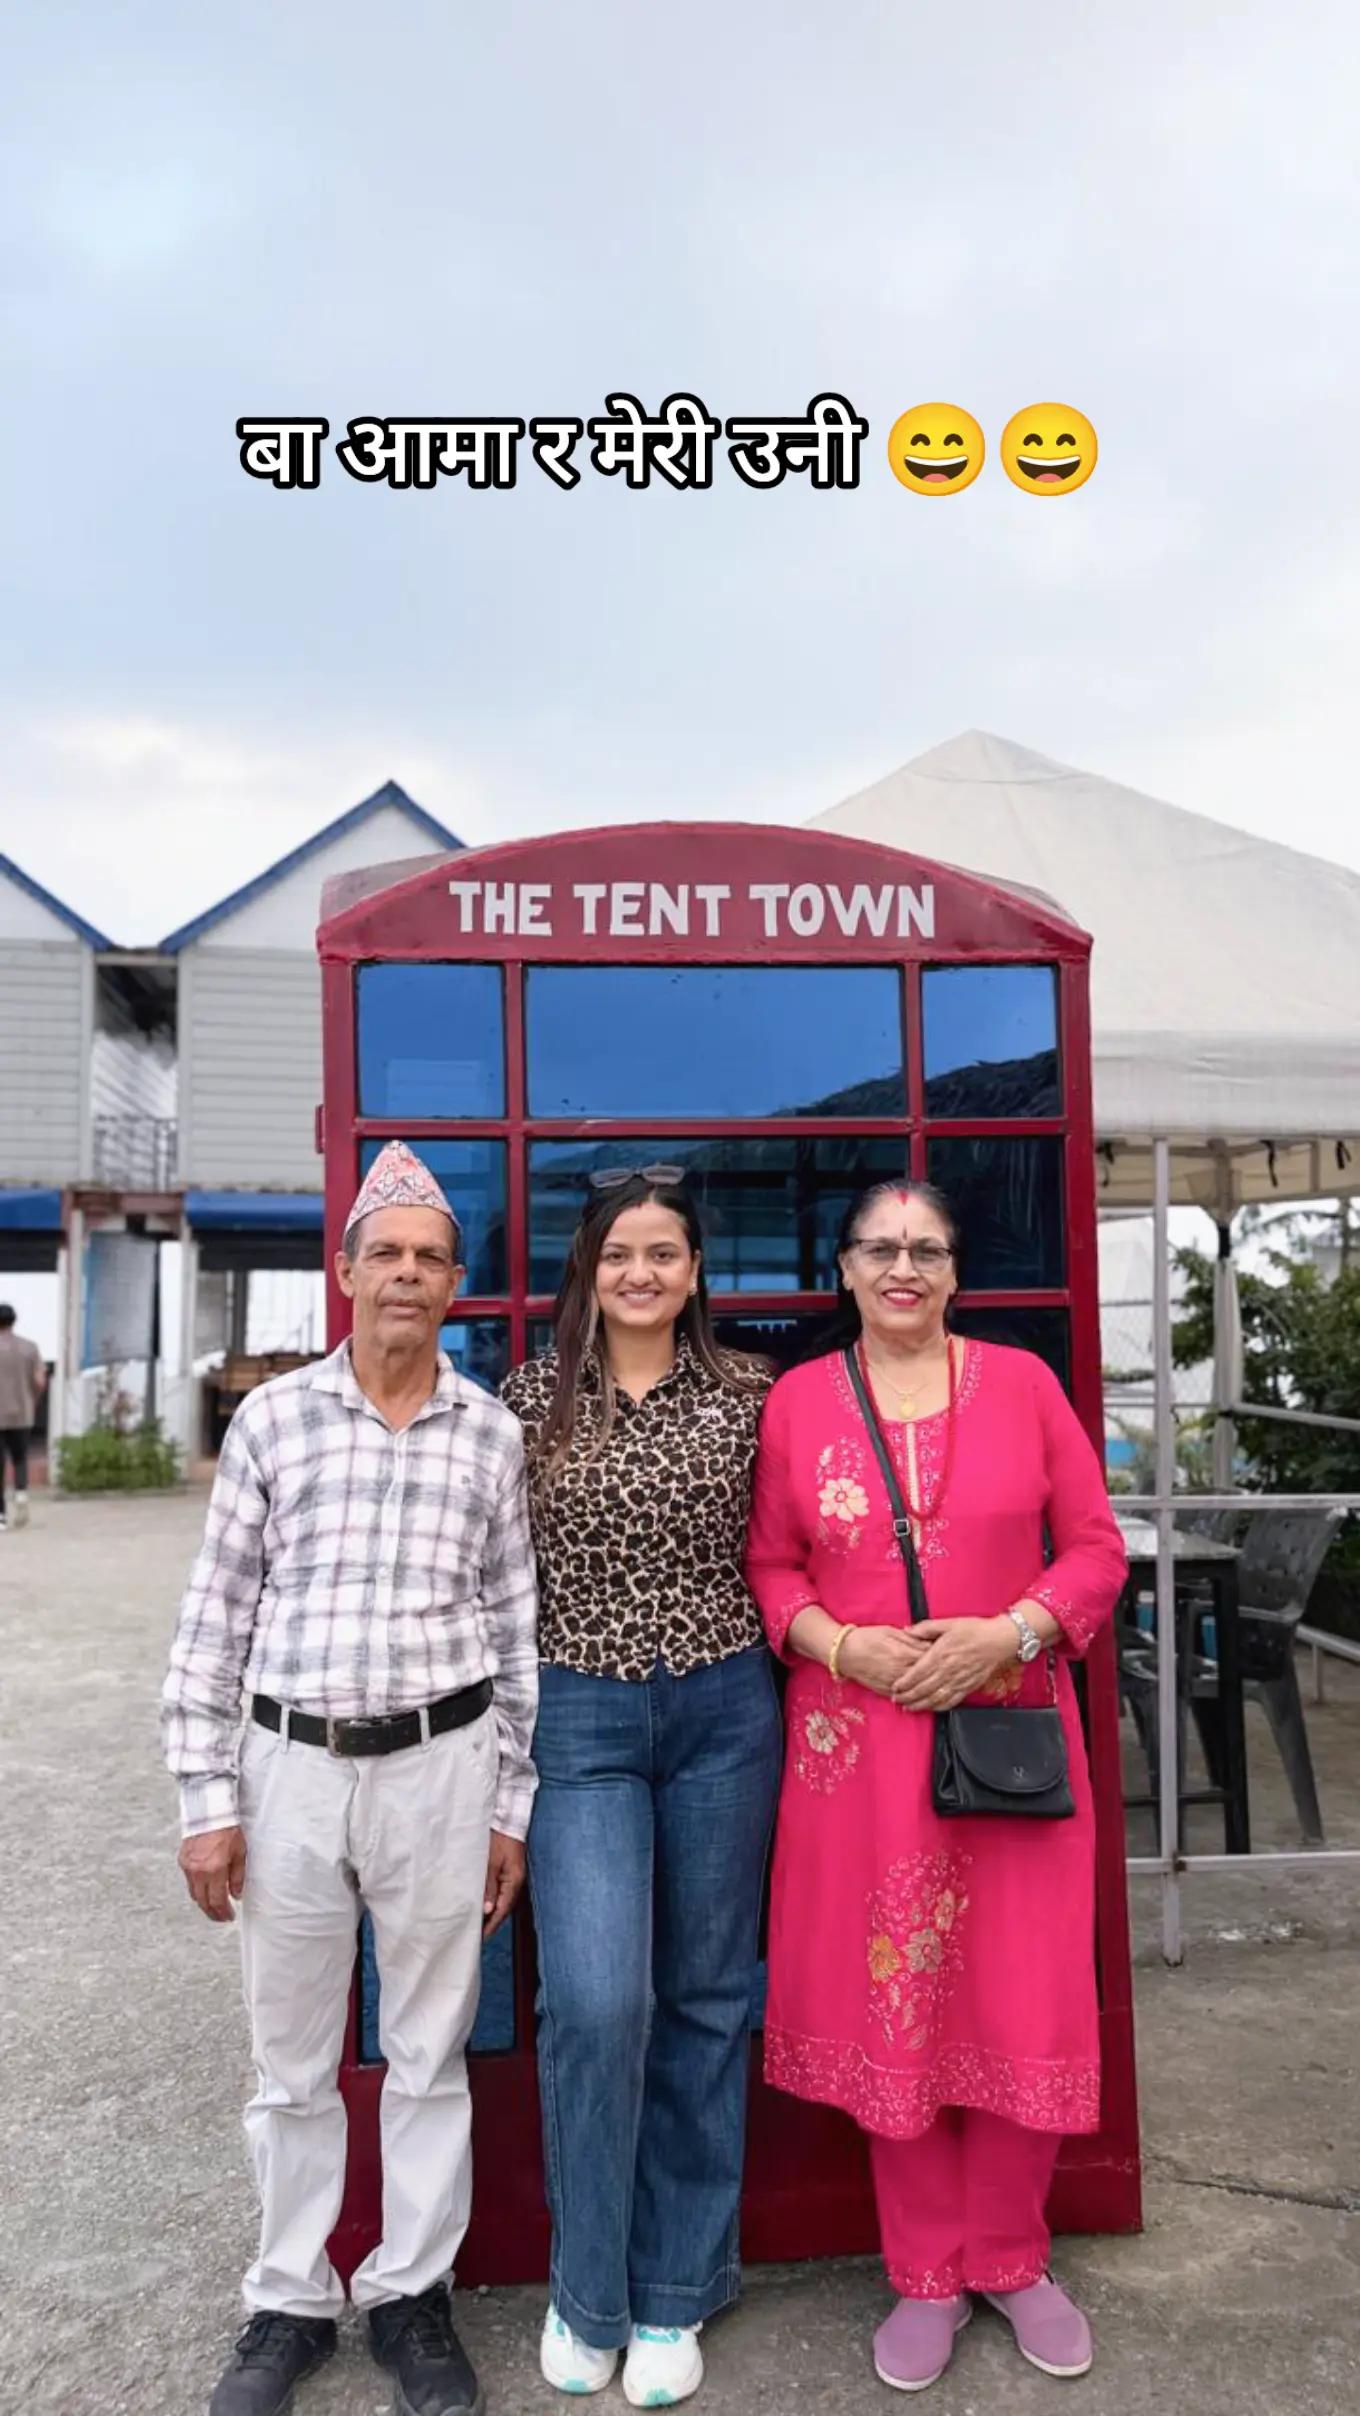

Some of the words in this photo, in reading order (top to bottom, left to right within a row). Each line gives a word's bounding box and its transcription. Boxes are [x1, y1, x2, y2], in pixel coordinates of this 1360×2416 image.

[449, 881, 552, 936] THE
[573, 882, 731, 936] TENT
[749, 883, 935, 938] TOWN
